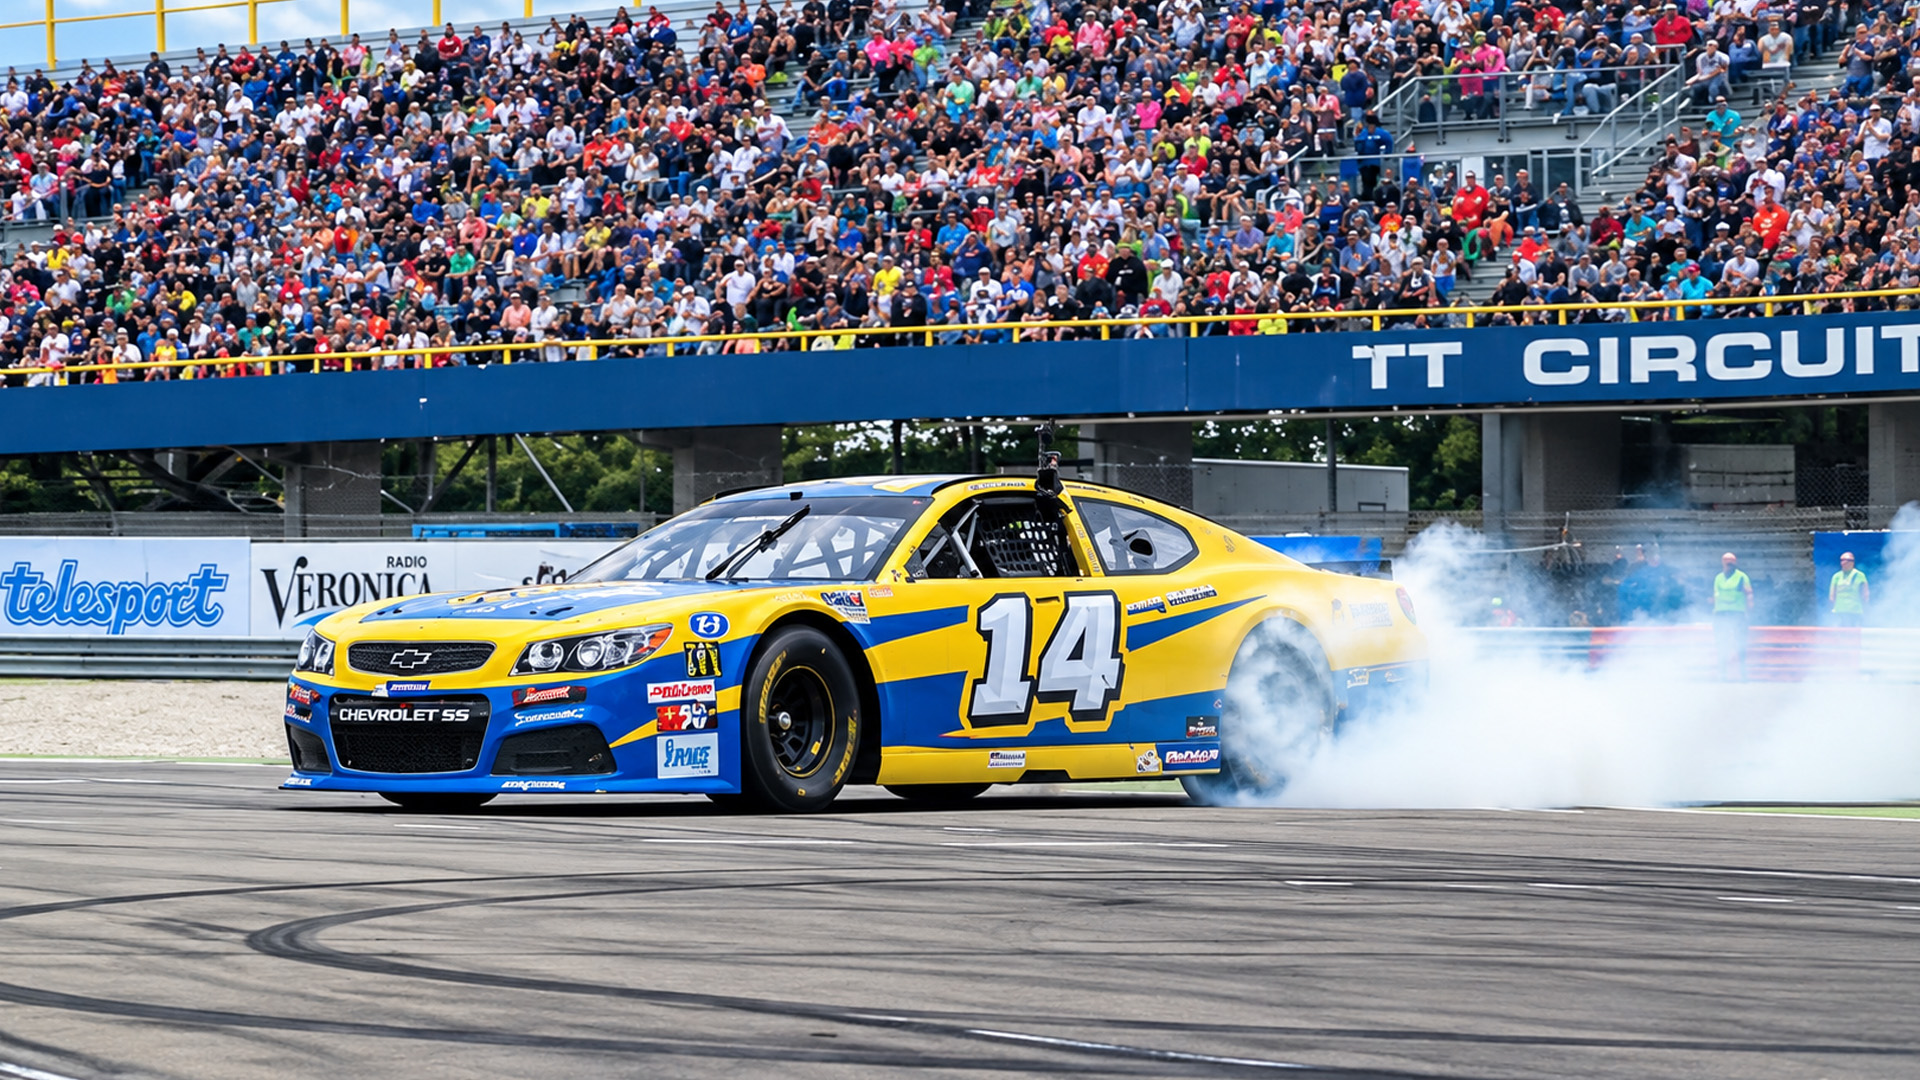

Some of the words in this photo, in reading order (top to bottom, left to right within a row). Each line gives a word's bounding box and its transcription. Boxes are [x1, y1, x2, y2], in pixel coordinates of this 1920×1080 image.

[1352, 341, 1462, 389] TT
[1523, 324, 1920, 386] CIRCUIT
[259, 556, 432, 629] VERONICA
[387, 556, 428, 568] RADIO
[1, 559, 229, 635] telesport
[967, 590, 1125, 728] 14
[339, 708, 439, 722] CHEVROLET
[441, 709, 470, 721] SS
